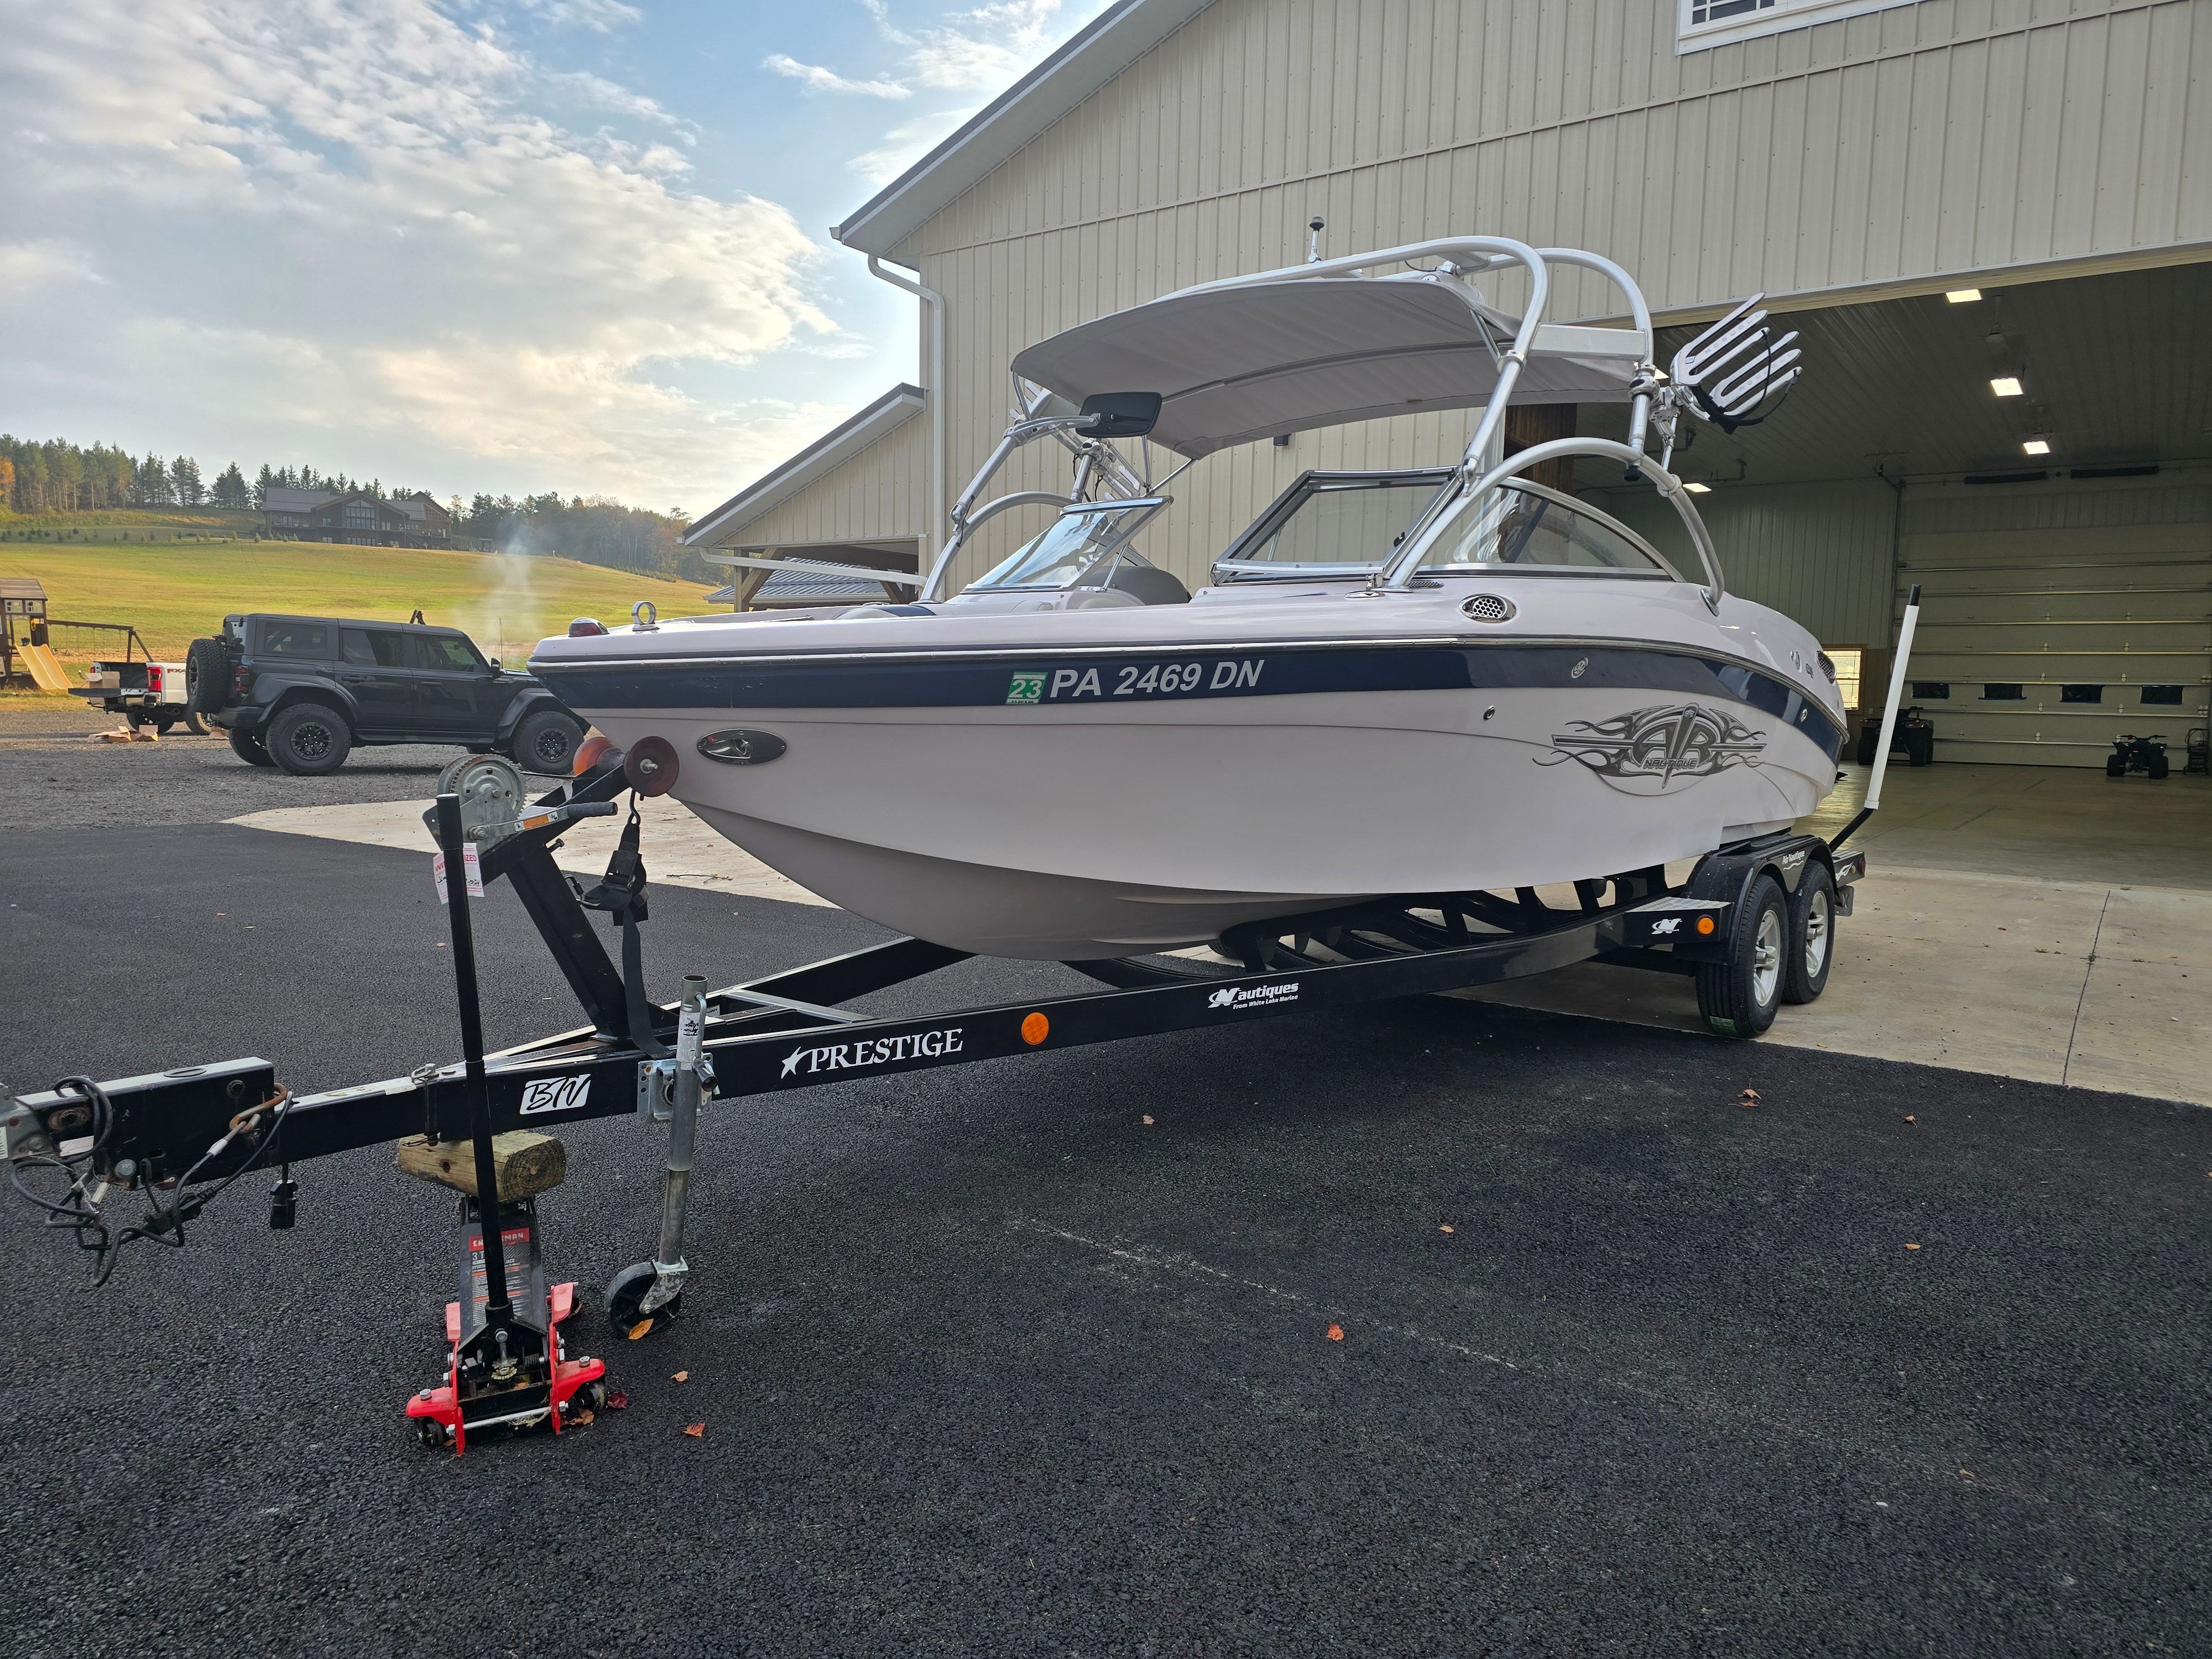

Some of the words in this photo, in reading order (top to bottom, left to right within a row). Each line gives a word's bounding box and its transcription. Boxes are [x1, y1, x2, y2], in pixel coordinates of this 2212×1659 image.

[1705, 314, 1761, 354] ROSWELL
[1008, 679, 1042, 698] 23
[1050, 667, 1103, 698] PA
[1113, 662, 1202, 696] 2469
[1209, 659, 1265, 690] DN
[1642, 757, 1698, 770] NAUTIQUE
[1788, 850, 1805, 862] Nautique
[1208, 983, 1299, 1008] Nautiques
[806, 1027, 963, 1073] PRESTIGE
[472, 1252, 478, 1261] 3
